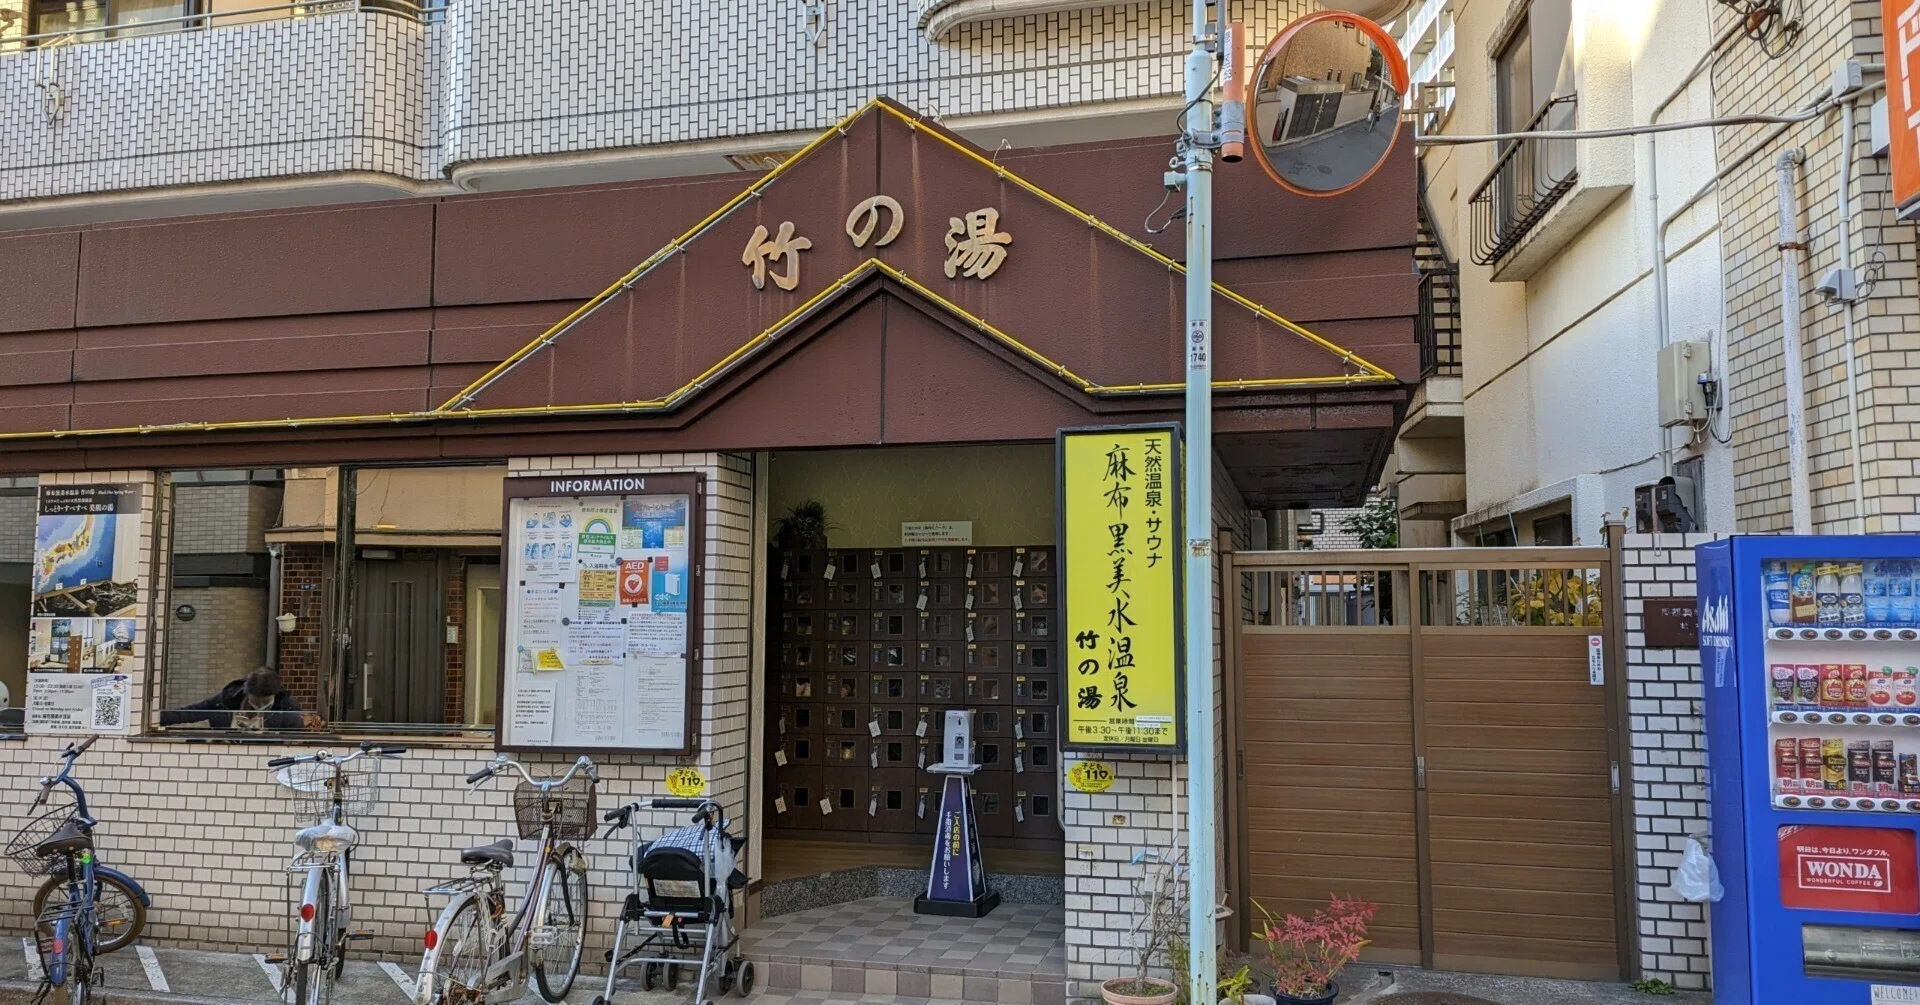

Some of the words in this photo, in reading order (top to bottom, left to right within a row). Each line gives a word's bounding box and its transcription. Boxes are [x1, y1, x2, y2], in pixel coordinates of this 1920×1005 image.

[742, 195, 1013, 291] 竹の湯
[550, 478, 645, 493] INFORMATION
[1144, 438, 1163, 569] 天然温泉・サウナ
[625, 561, 645, 570] AED
[1102, 443, 1138, 713] 麻布黒美水温泉
[1702, 594, 1729, 633] Asahi
[1075, 630, 1103, 710] 竹の湯
[1108, 717, 1135, 725] 営業時間
[678, 767, 697, 777] 子ども
[1081, 762, 1103, 770] 子ども
[952, 811, 961, 856] ご入店の前に
[1796, 845, 1890, 857] 明日は、今日より、ワンダフル。
[1806, 860, 1882, 880] WONDA
